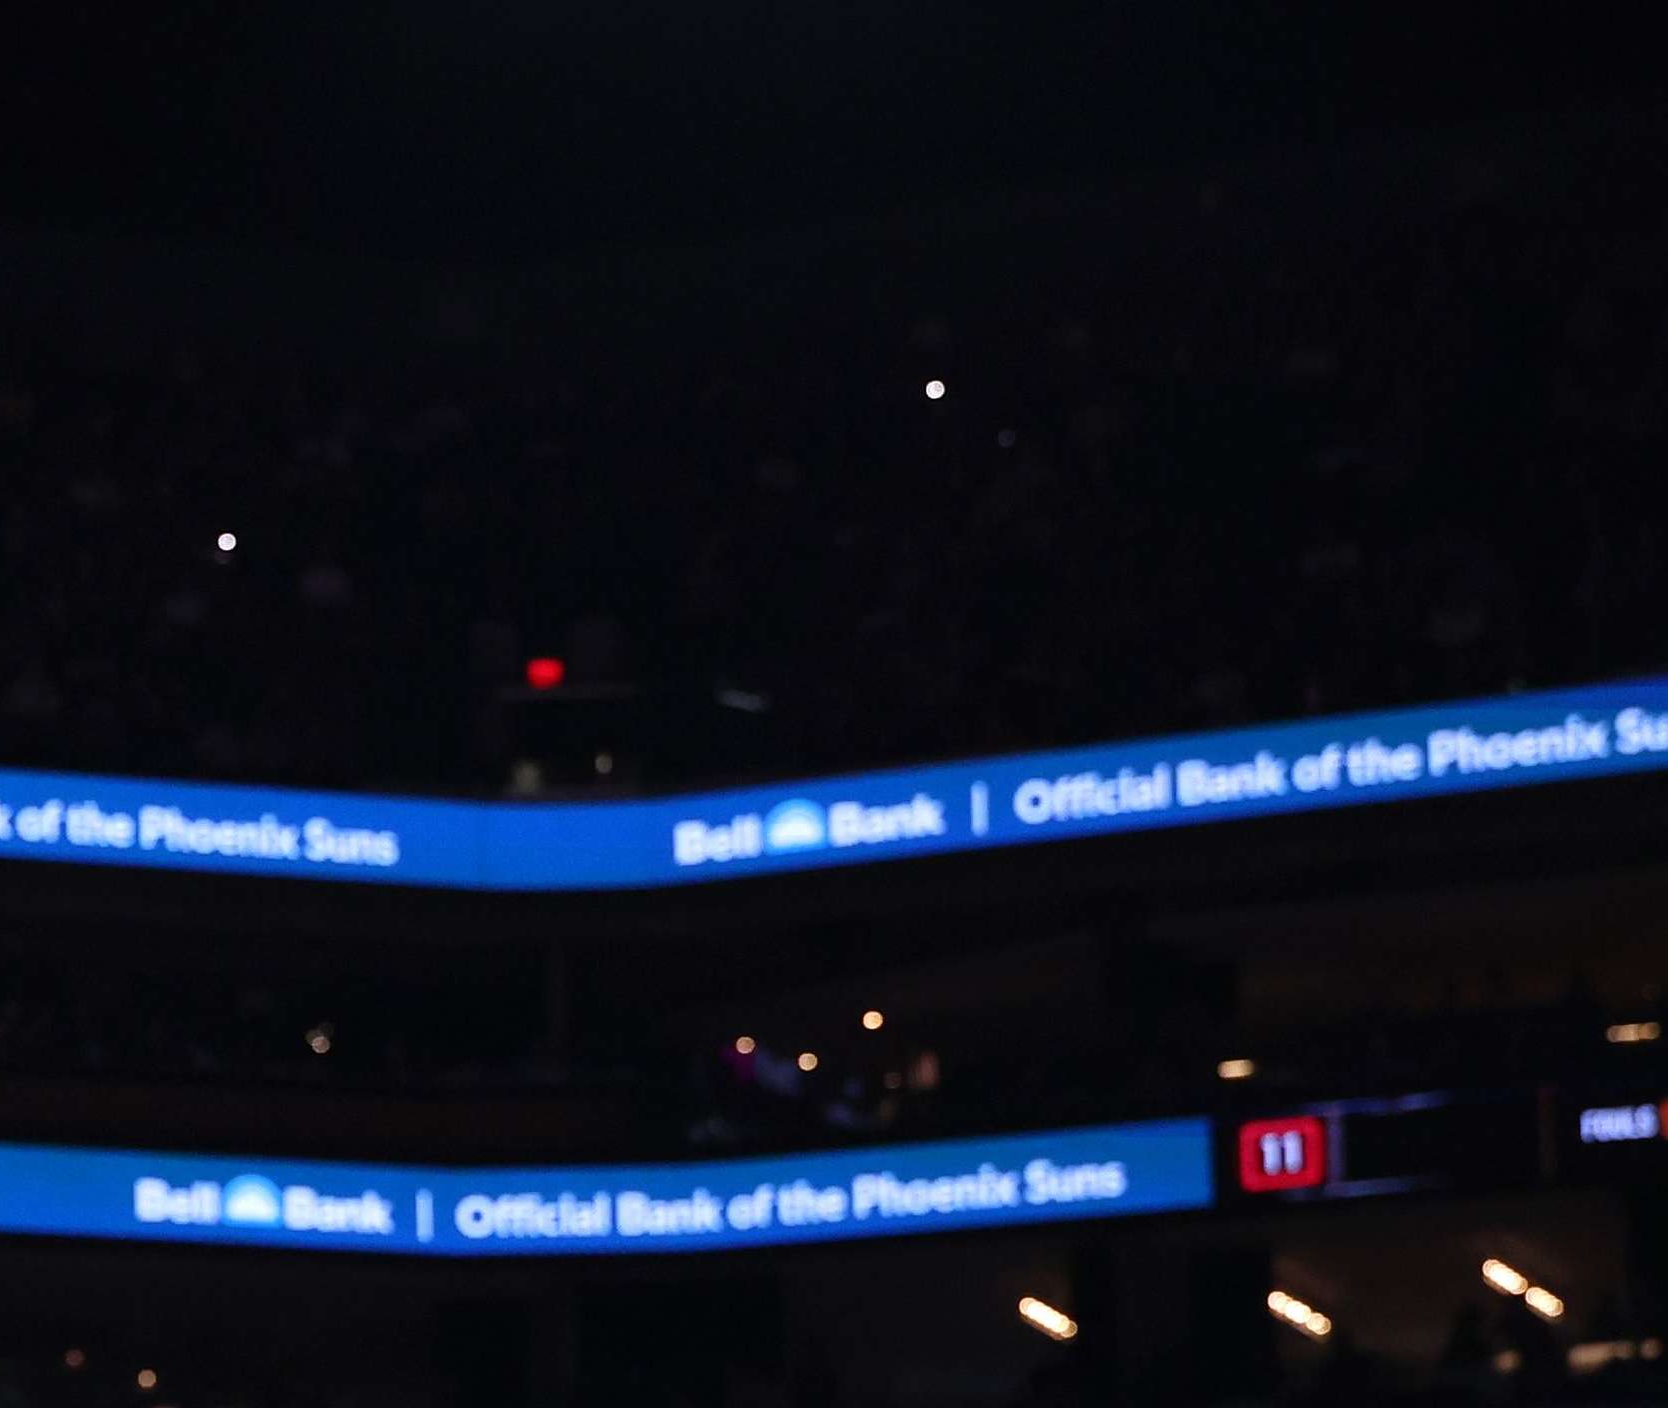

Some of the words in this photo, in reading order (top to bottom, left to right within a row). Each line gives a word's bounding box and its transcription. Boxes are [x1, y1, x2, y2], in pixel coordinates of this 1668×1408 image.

[674, 816, 763, 865] Bell
[827, 795, 943, 846] Bank
[1014, 766, 1169, 824] Official
[1177, 754, 1285, 805] Bank
[1293, 746, 1346, 791] of
[1345, 741, 1421, 785] the
[1428, 717, 1607, 775] Phoenix
[1615, 708, 1668, 753] Su
[16, 800, 65, 841] of
[65, 804, 132, 847] the
[139, 806, 299, 858] Phoenix
[304, 818, 398, 865] Suns
[1262, 1131, 1303, 1176] 11
[135, 1178, 221, 1223] Bell
[283, 1187, 391, 1233] Bank
[455, 1194, 609, 1238] Official
[616, 1191, 721, 1236] Bank
[727, 1185, 777, 1229] of
[777, 1183, 847, 1225] the
[852, 1165, 1018, 1218] Phoenix
[1025, 1160, 1125, 1204] Suns
